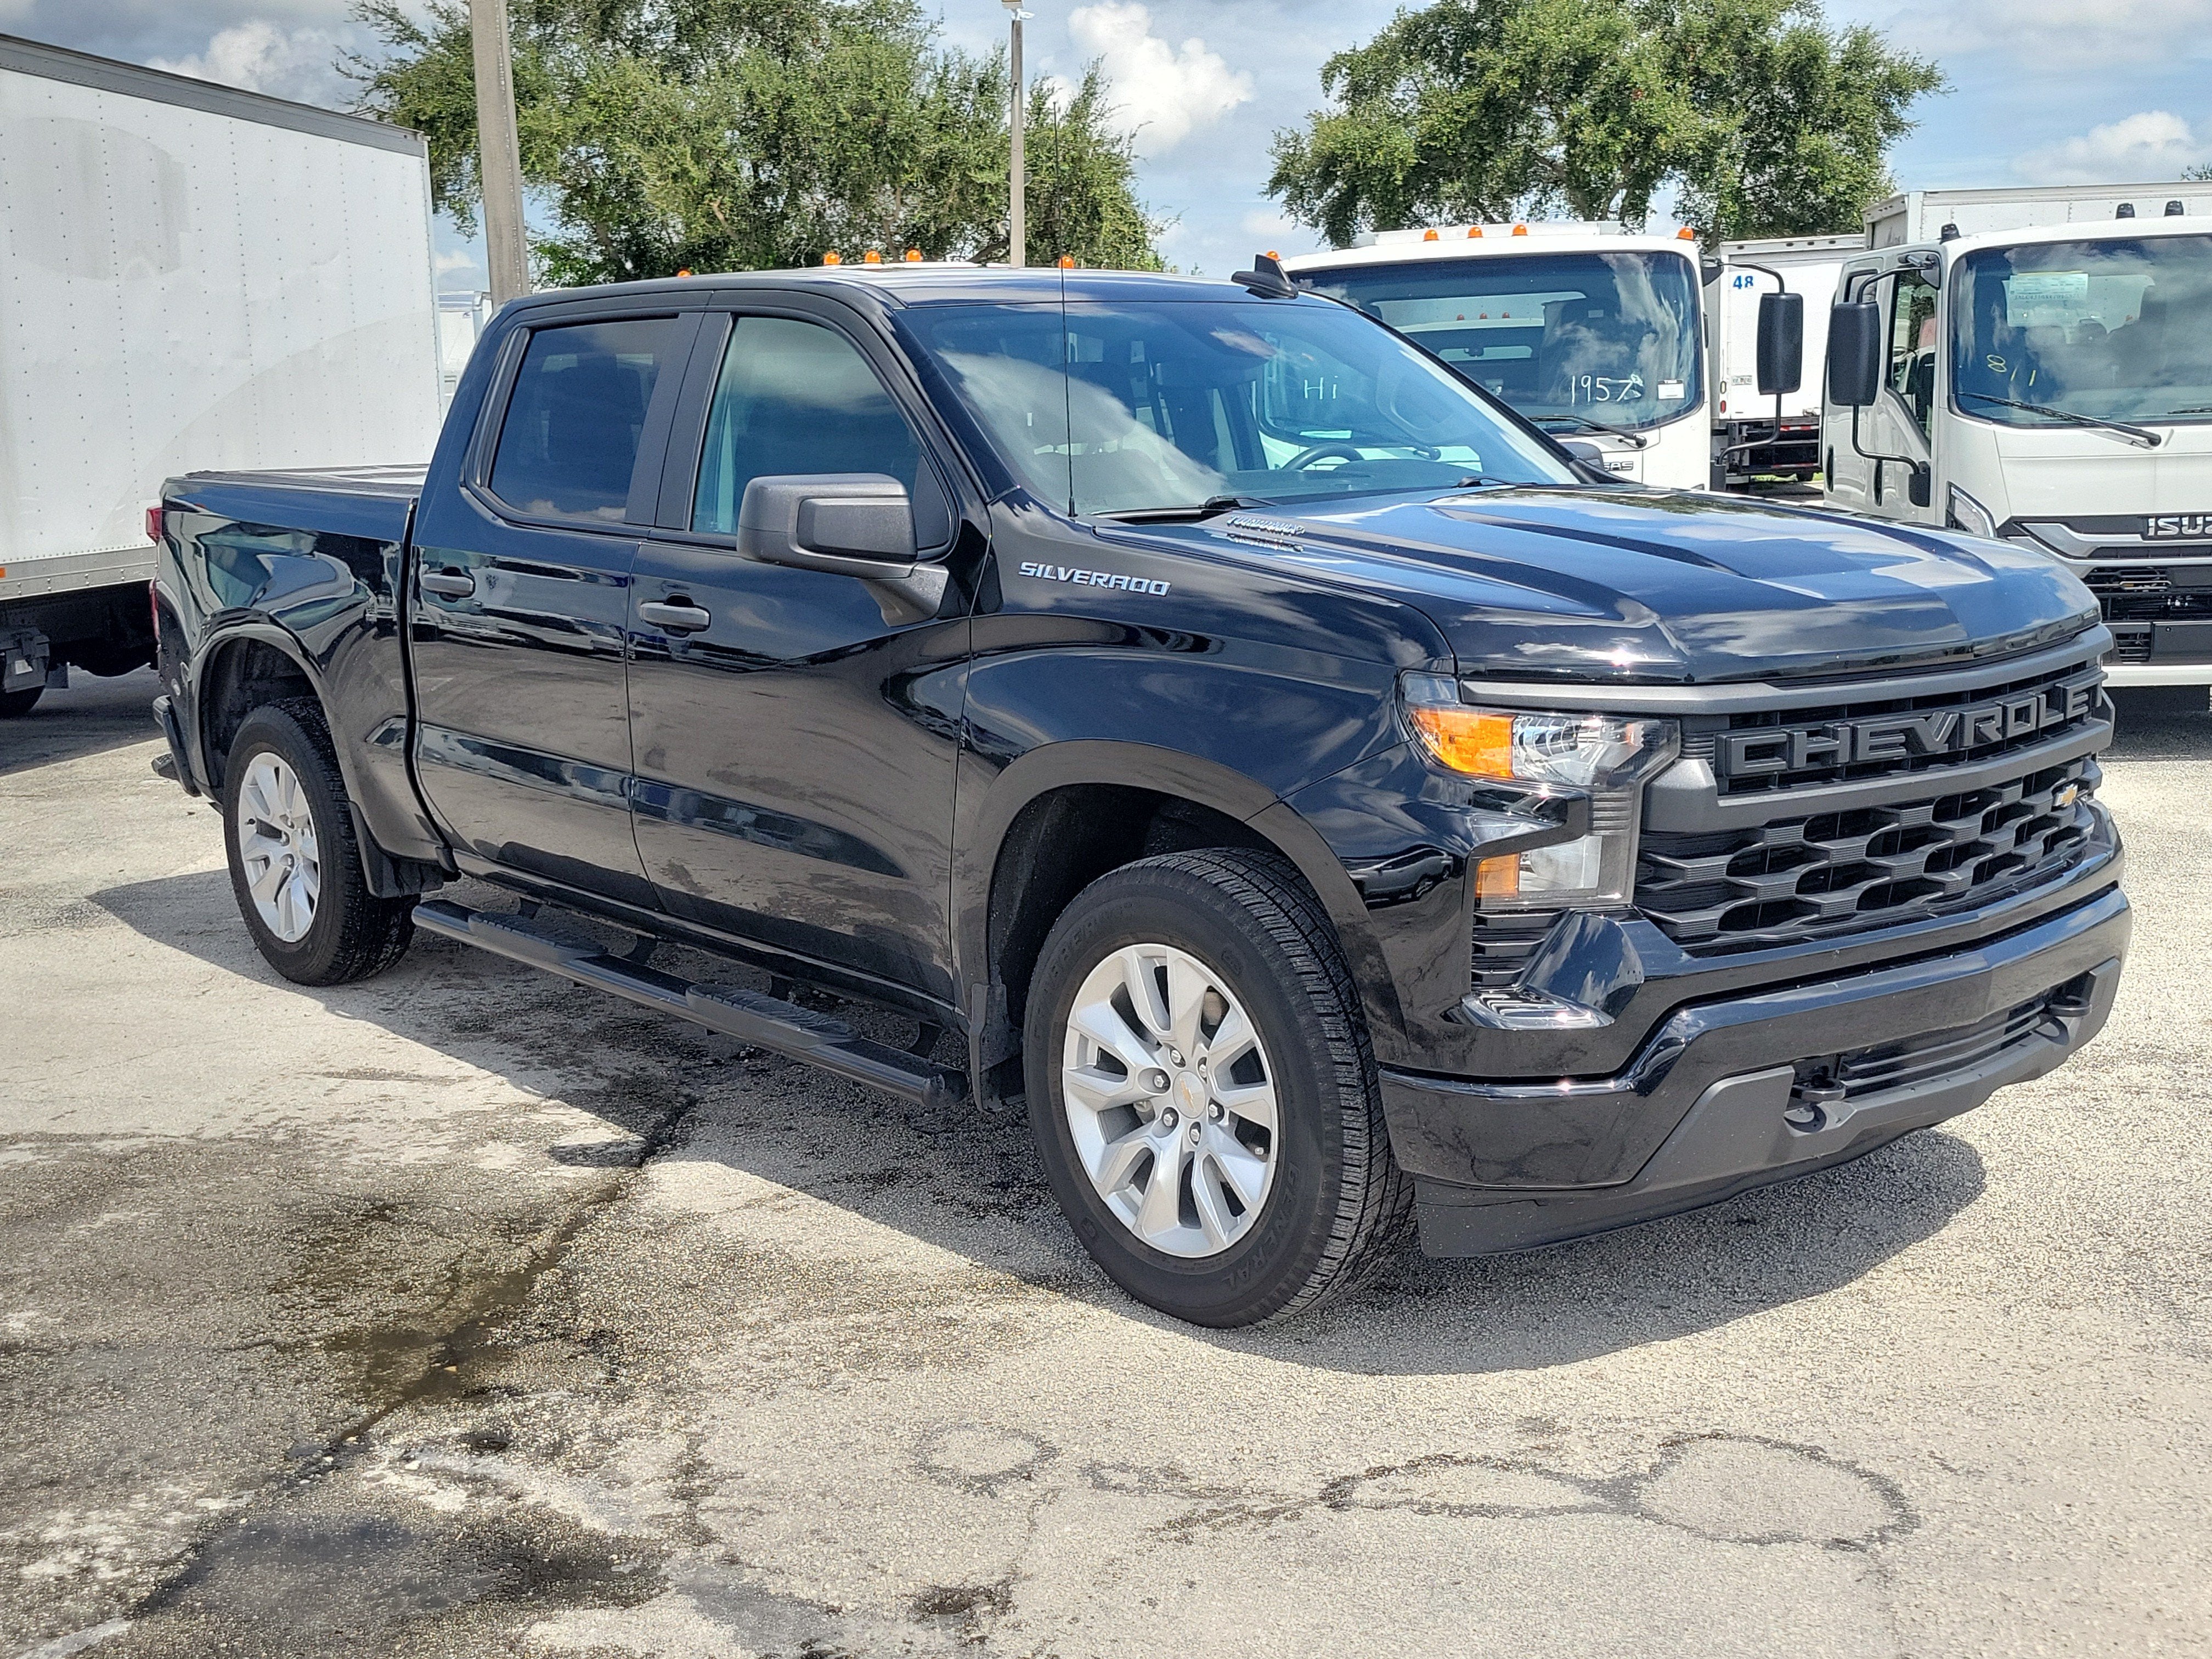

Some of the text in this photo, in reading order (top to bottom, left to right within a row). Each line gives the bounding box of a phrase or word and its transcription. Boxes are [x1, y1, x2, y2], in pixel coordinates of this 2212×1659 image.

[1733, 275, 1754, 290] 48
[1304, 375, 1339, 400] Hi
[1018, 561, 1171, 597] SILVERADO
[1221, 1161, 1302, 1291] GENERAL
